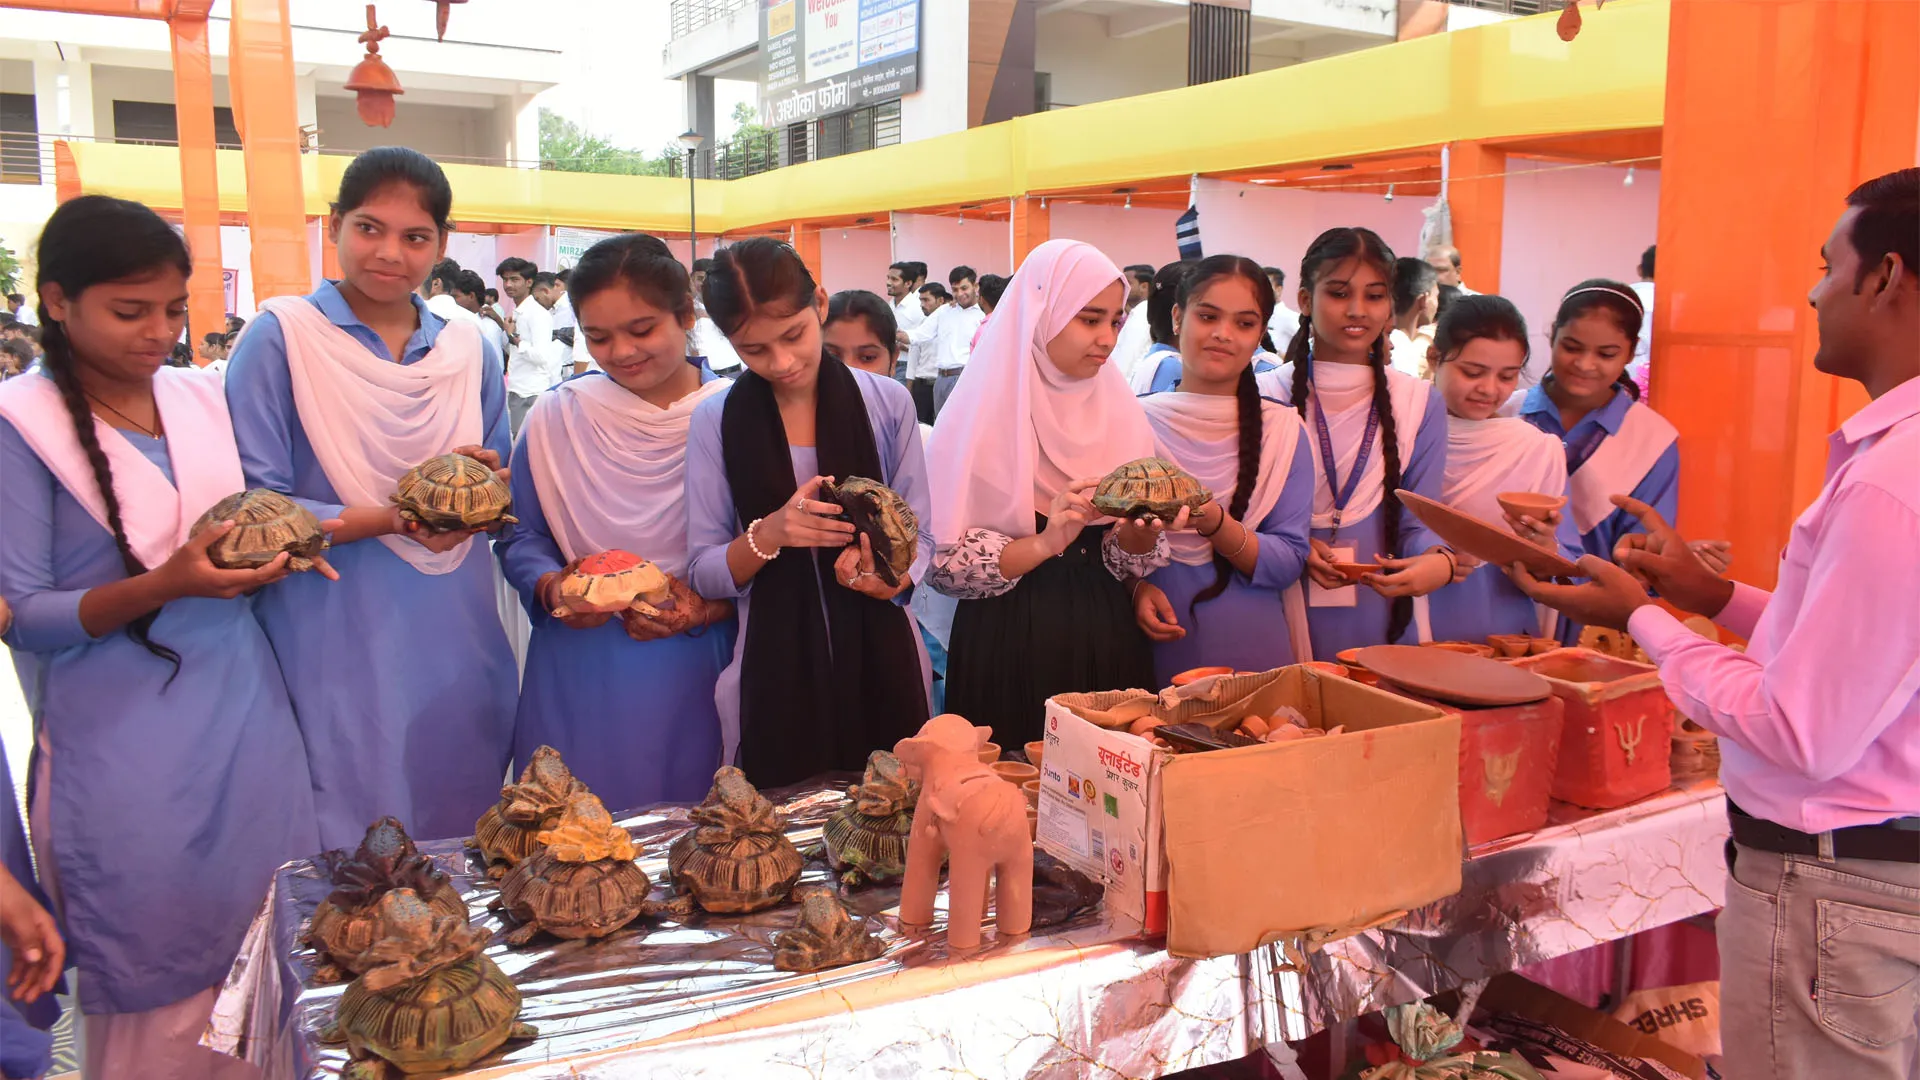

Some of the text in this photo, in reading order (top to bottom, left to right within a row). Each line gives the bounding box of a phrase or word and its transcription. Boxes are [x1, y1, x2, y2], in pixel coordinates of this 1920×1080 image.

[808, 0, 845, 14] Welco
[825, 12, 838, 29] You
[776, 89, 816, 121] अशोका
[818, 78, 847, 110] फोम
[1097, 746, 1142, 778] यूनाईटेड
[1121, 776, 1139, 792] कुकर
